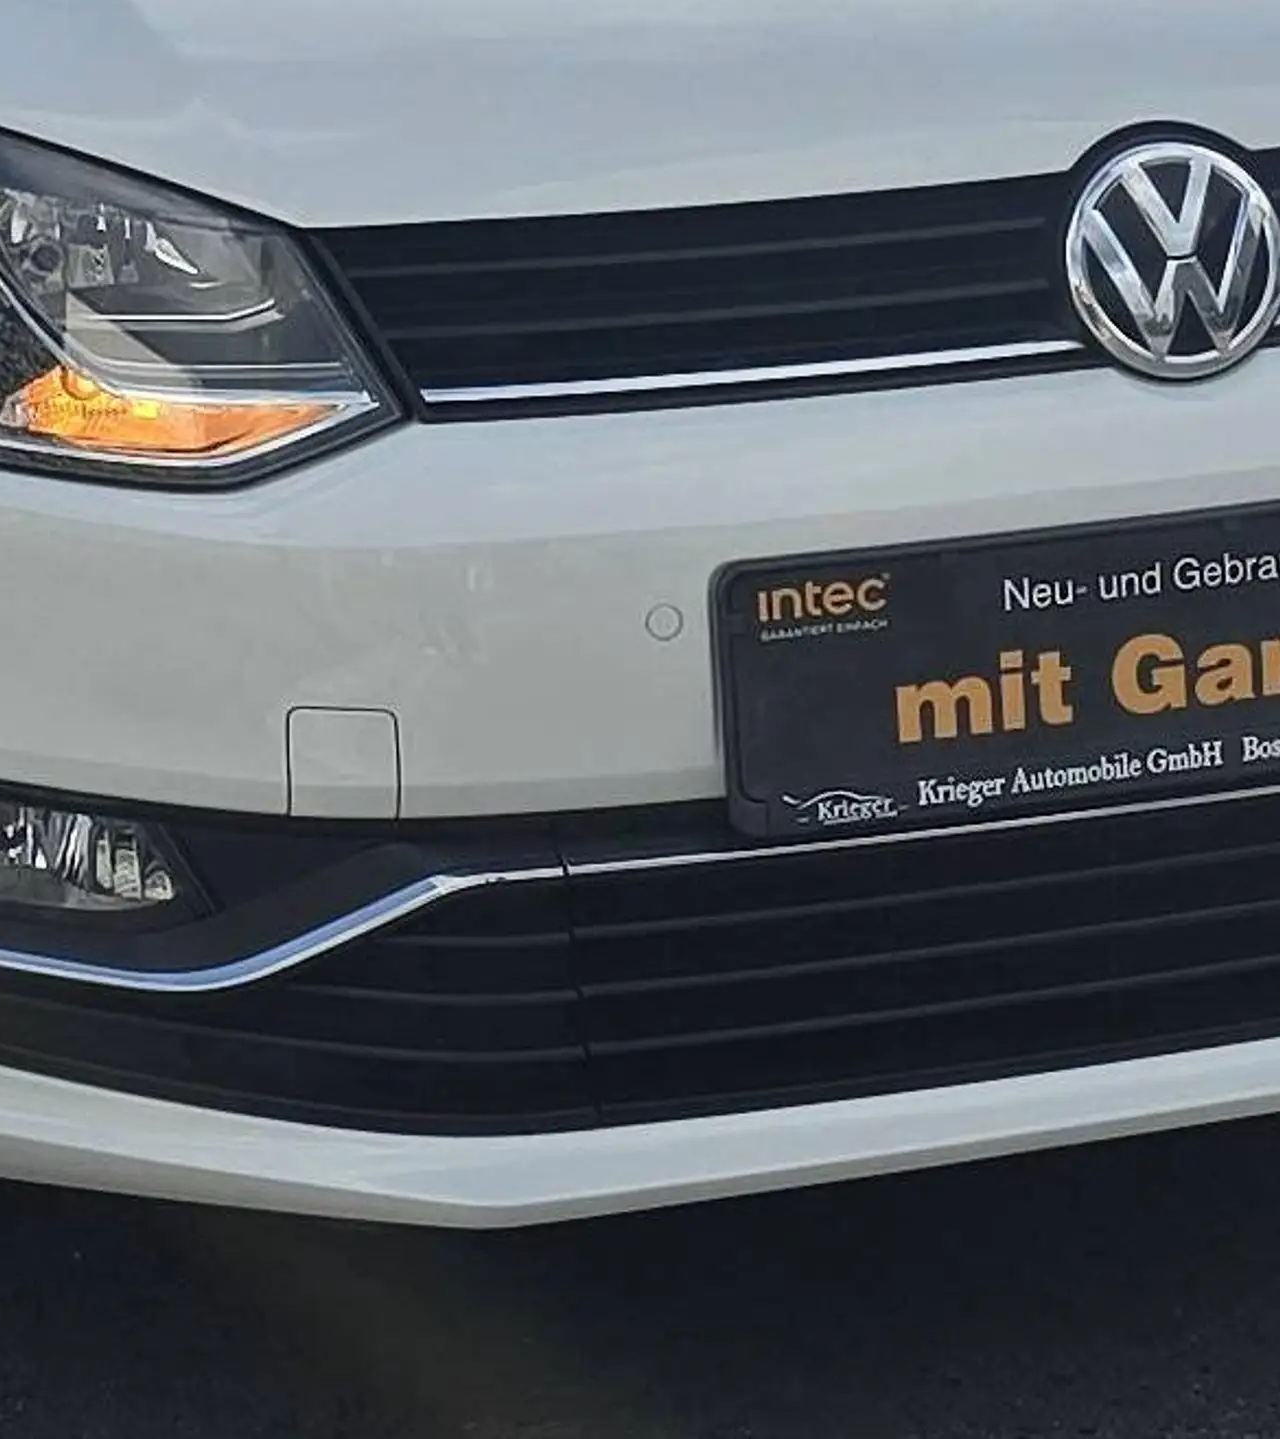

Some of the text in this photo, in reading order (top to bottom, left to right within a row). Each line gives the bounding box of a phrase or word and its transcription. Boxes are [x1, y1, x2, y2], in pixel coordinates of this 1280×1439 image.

[1072, 150, 1276, 368] VW
[1003, 576, 1087, 611] Neu-
[1098, 562, 1161, 600] und
[895, 649, 1074, 744] mit
[918, 776, 1006, 808] Krieger
[1010, 752, 1142, 794] Automobile
[1146, 740, 1224, 774] GmbH
